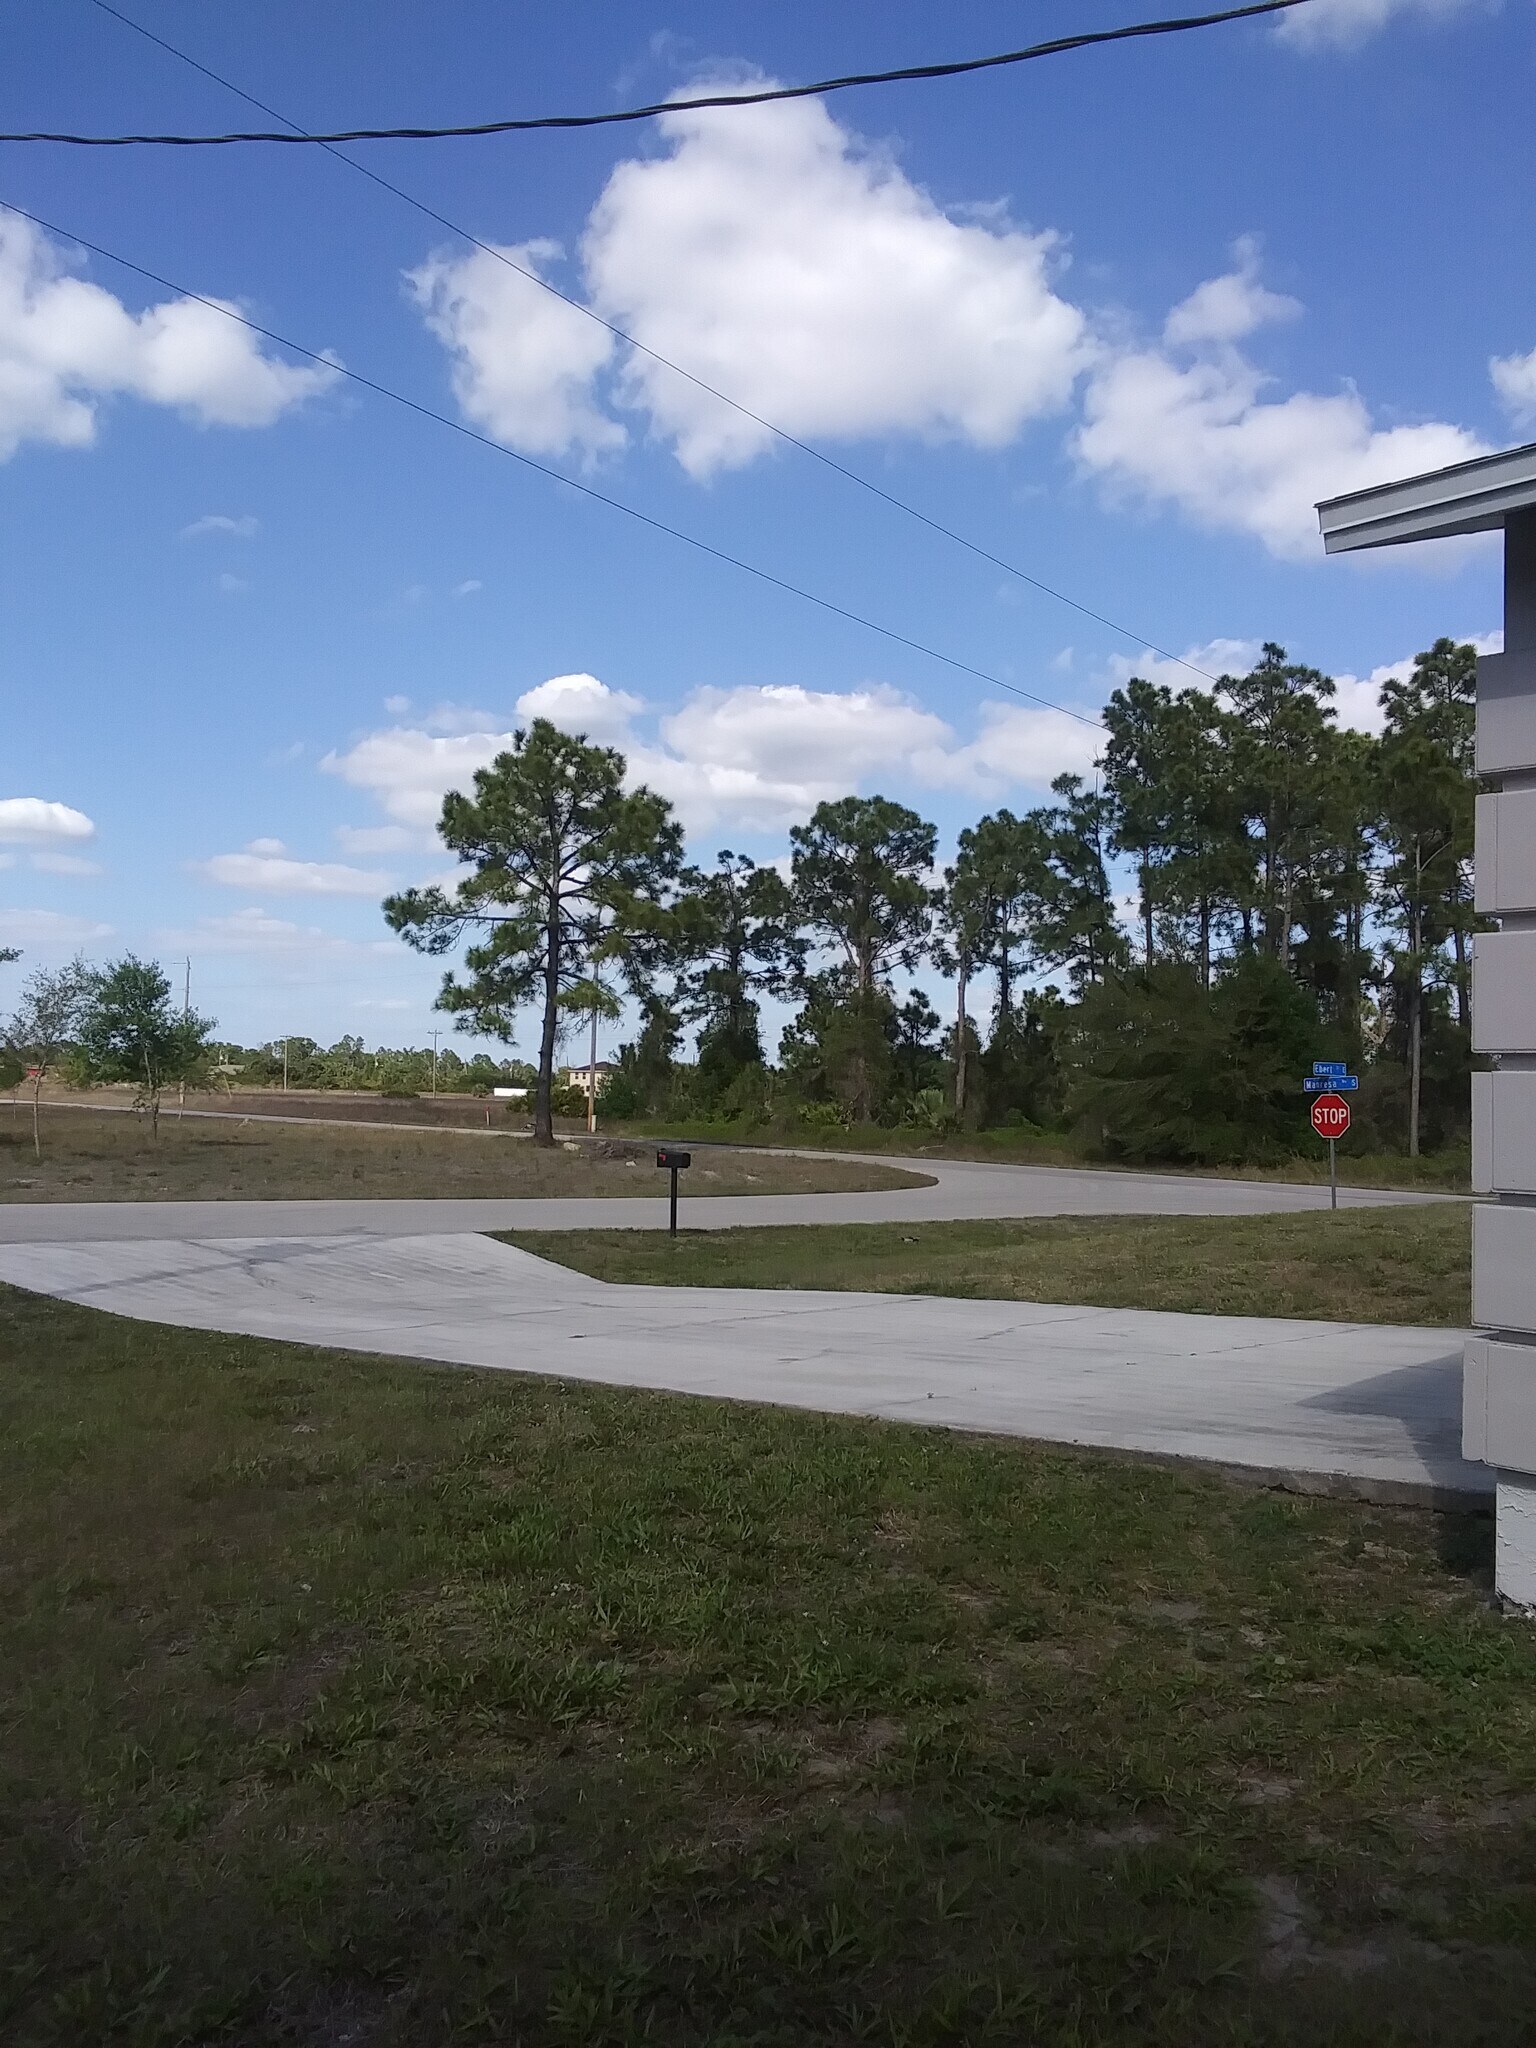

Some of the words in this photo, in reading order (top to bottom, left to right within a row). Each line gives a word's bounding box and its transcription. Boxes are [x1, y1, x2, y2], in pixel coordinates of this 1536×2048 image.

[1315, 1064, 1333, 1074] Ebert
[1351, 1079, 1356, 1087] S
[1314, 1107, 1347, 1124] STOP
